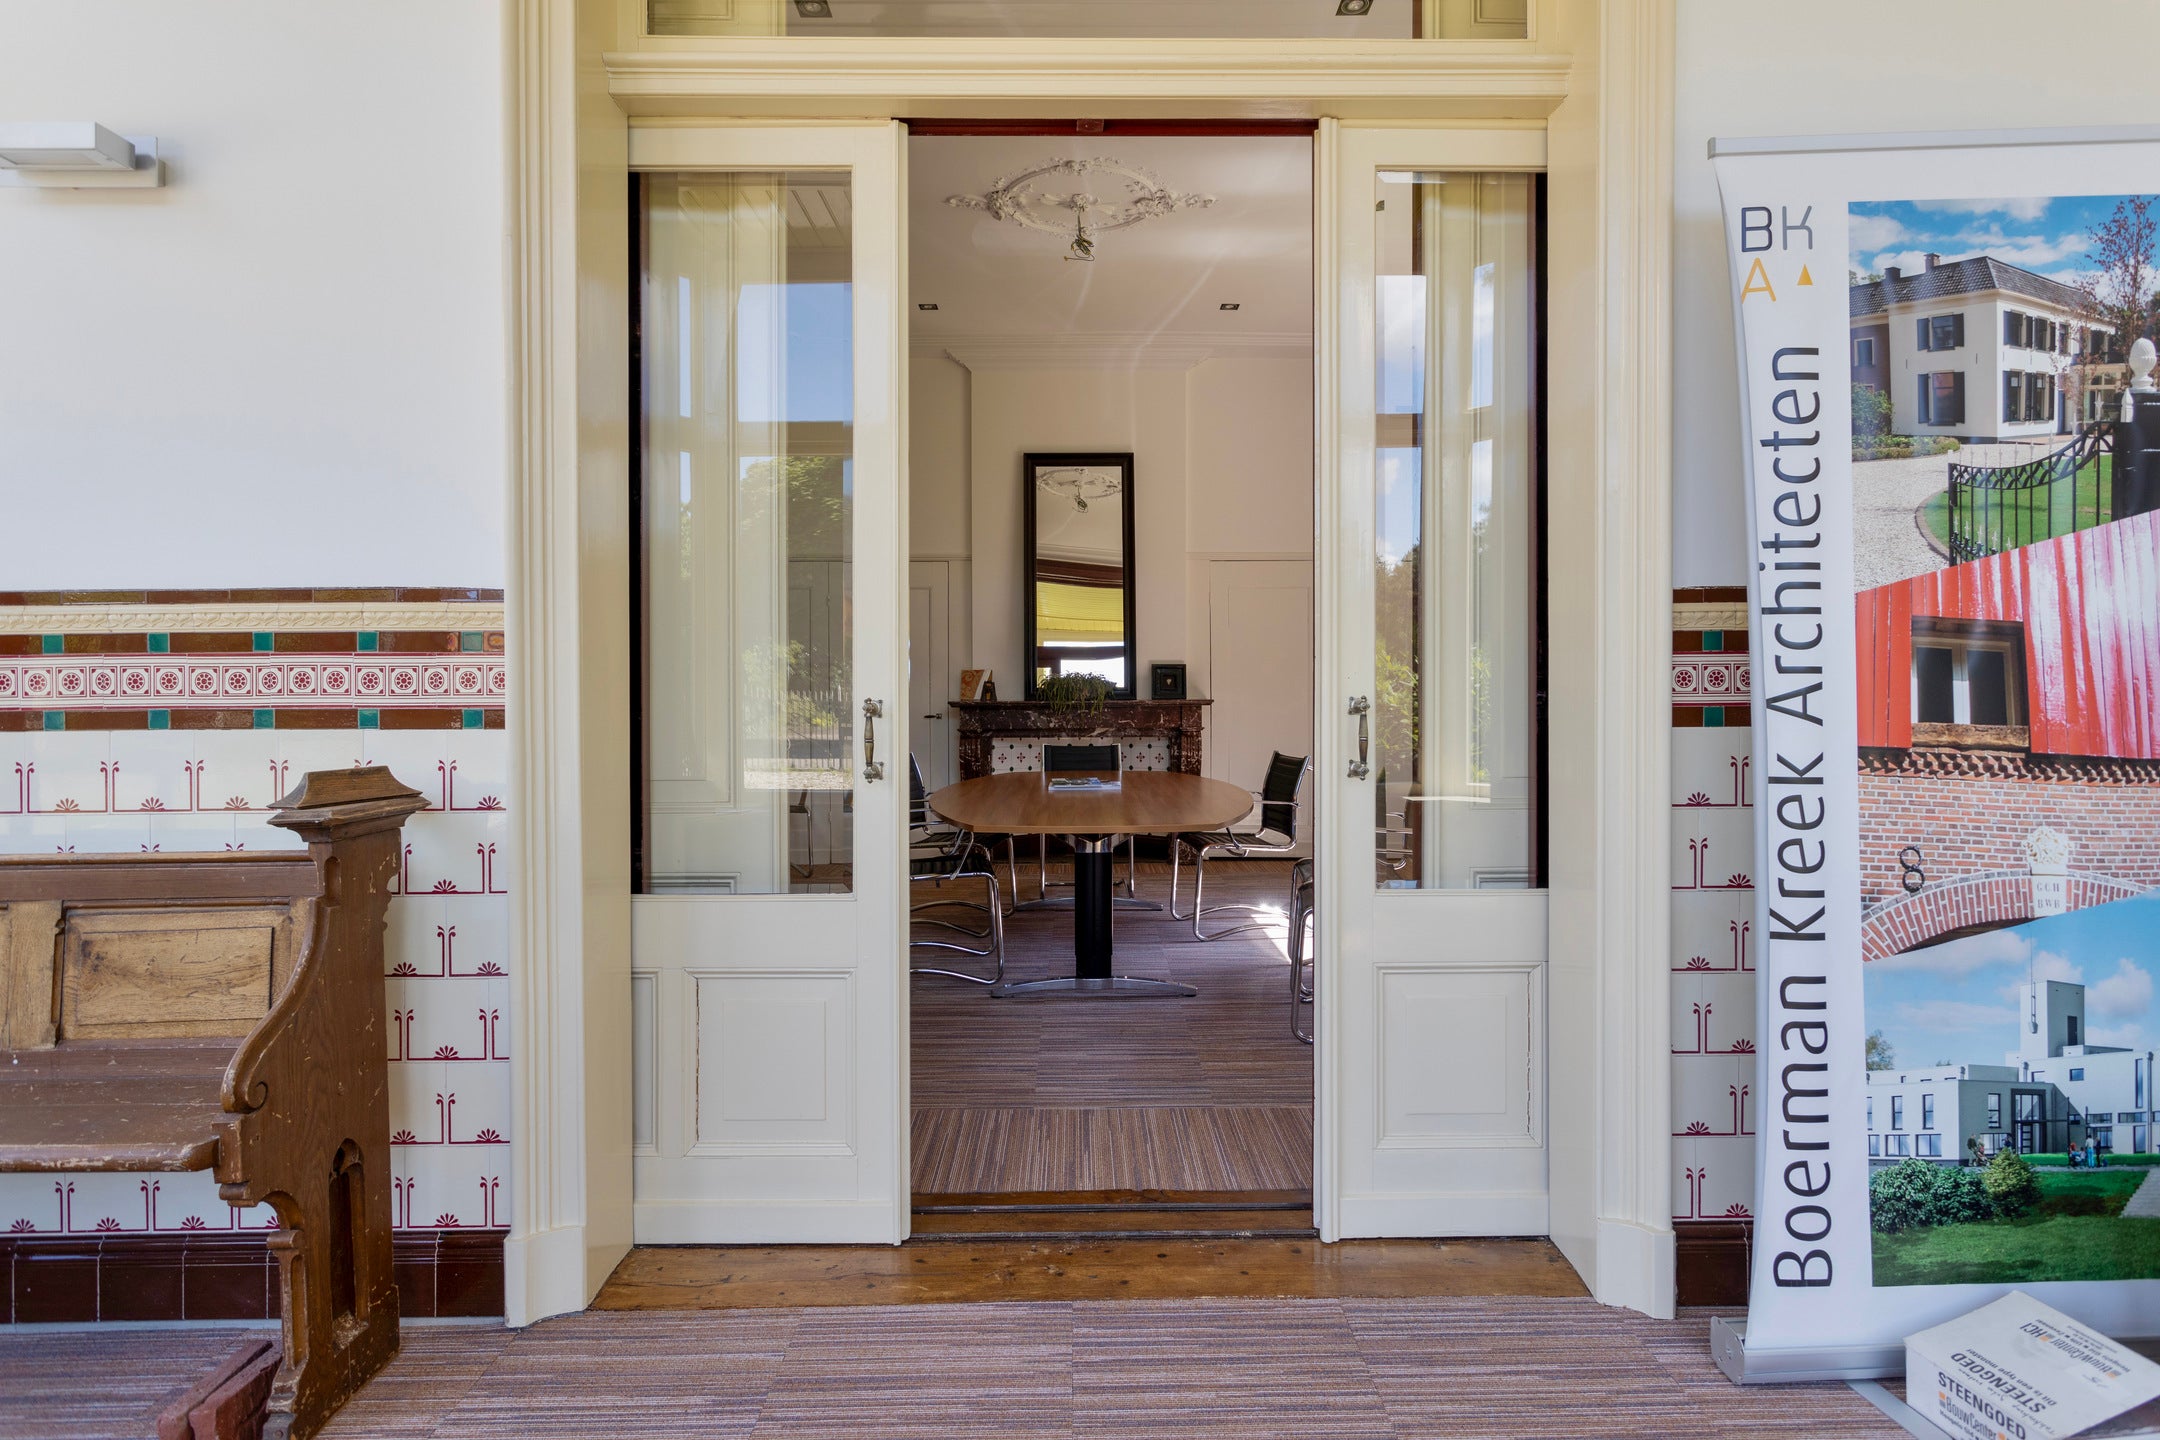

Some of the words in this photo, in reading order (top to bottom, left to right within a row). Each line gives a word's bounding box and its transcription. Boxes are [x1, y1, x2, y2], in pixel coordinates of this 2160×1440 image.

[1759, 347, 1824, 727] Architecten
[1768, 752, 1826, 941] Kreek
[1773, 975, 1833, 1288] Boerman
[1938, 1371, 2026, 1440] STEENGOED
[1950, 1352, 2046, 1413] STEENGOED
[1998, 1367, 2017, 1381] type
